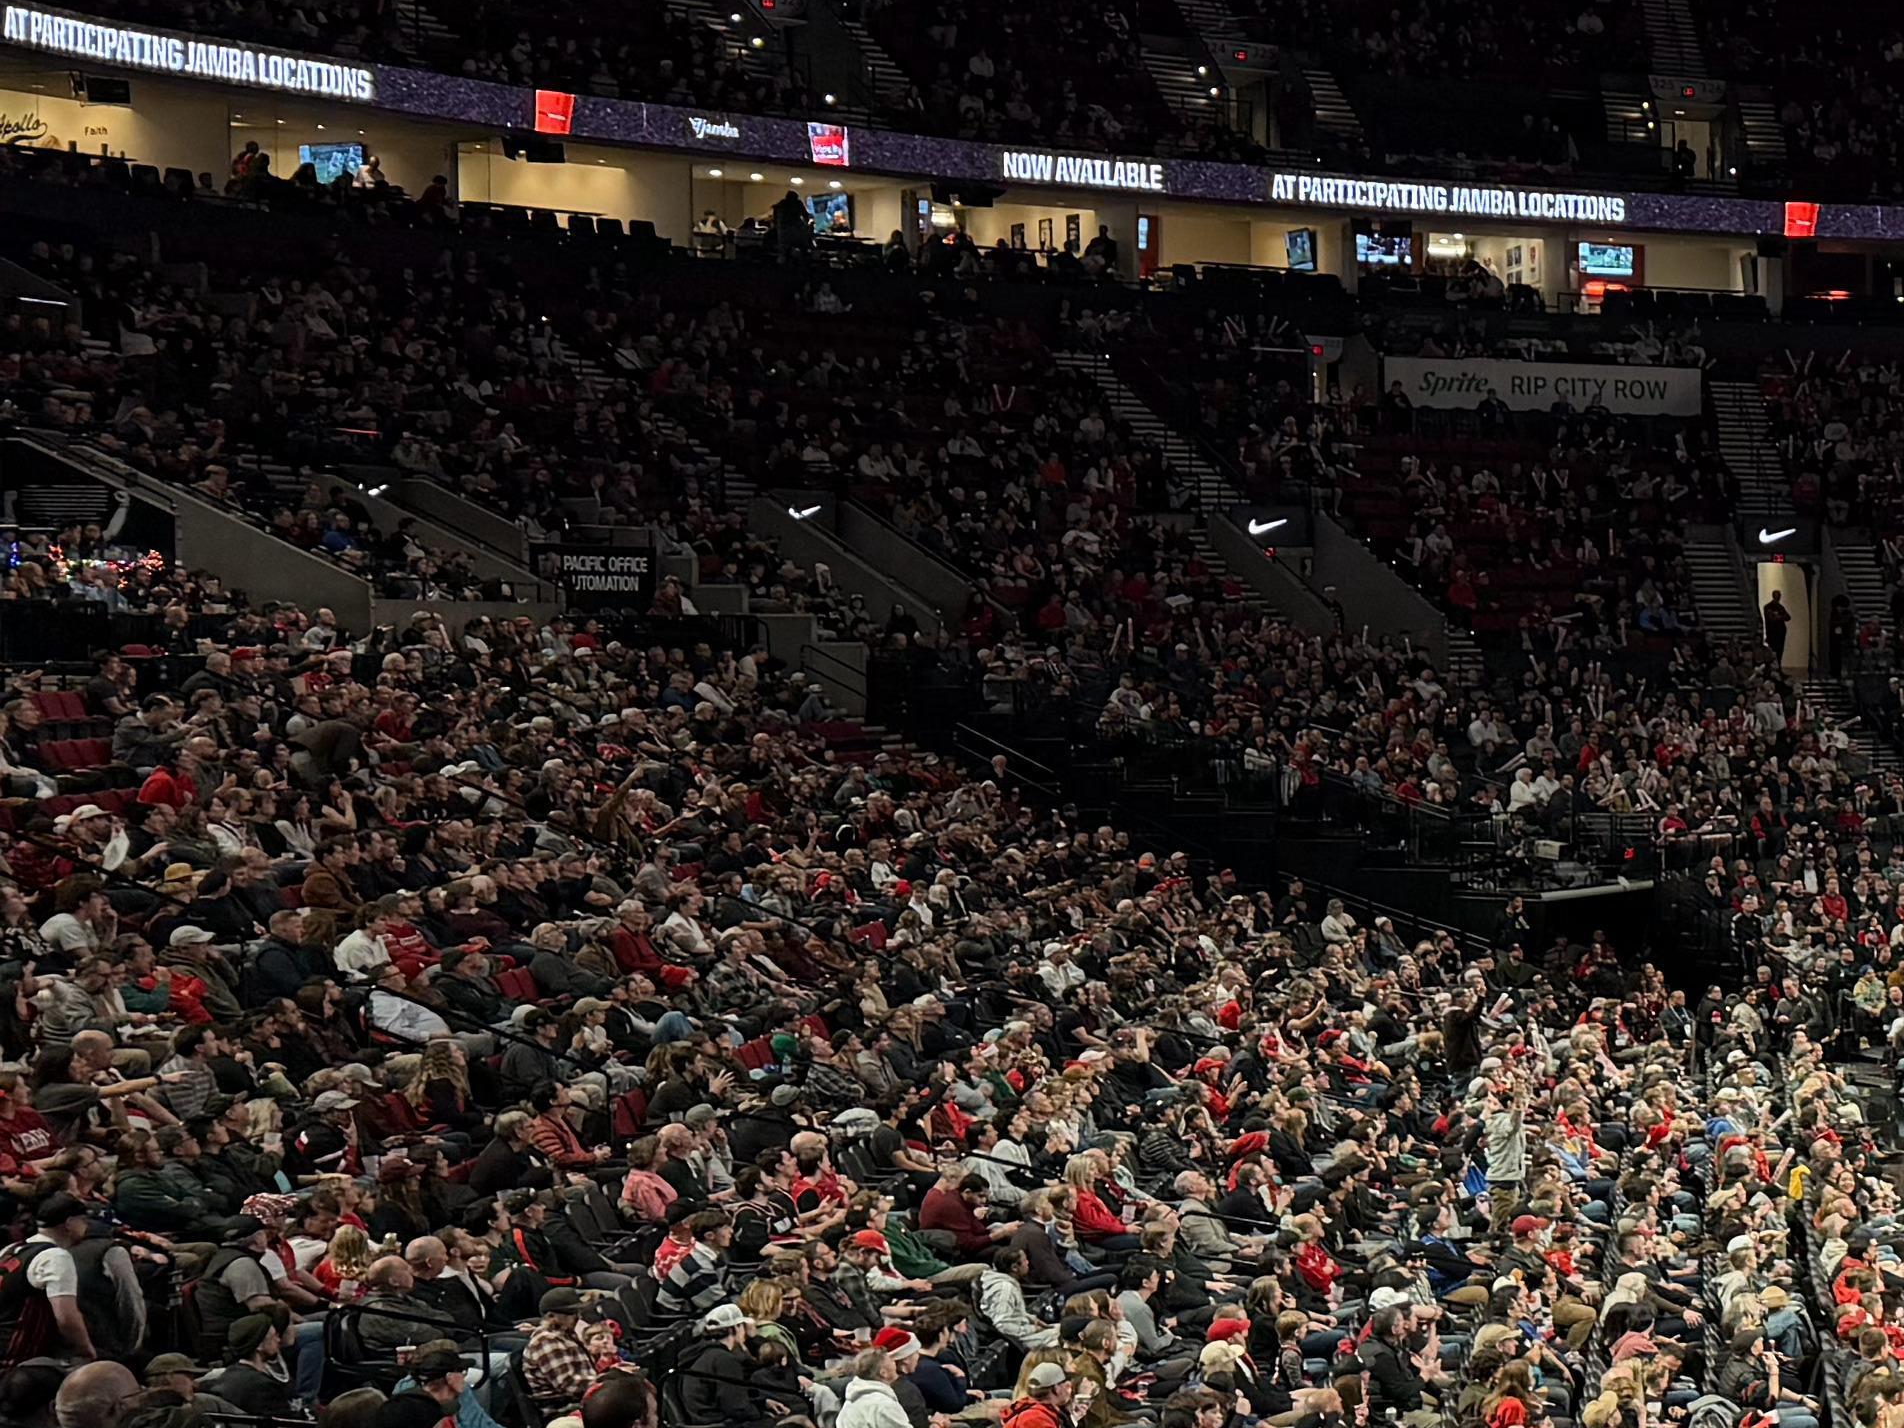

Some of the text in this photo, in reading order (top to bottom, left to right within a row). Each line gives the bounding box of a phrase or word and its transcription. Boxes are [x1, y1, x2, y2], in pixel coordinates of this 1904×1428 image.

[4, 5, 375, 99] AT PARTICIPATING JAMBA LOCATIONS
[1003, 149, 1163, 192] NOW AVAILABLE
[1272, 174, 1625, 222] AT PARTICIPATING JAMBA LOCATIONS
[1419, 371, 1667, 399] Sprite RIP CITY ROW
[563, 555, 648, 572] PACIFIC OFFICE
